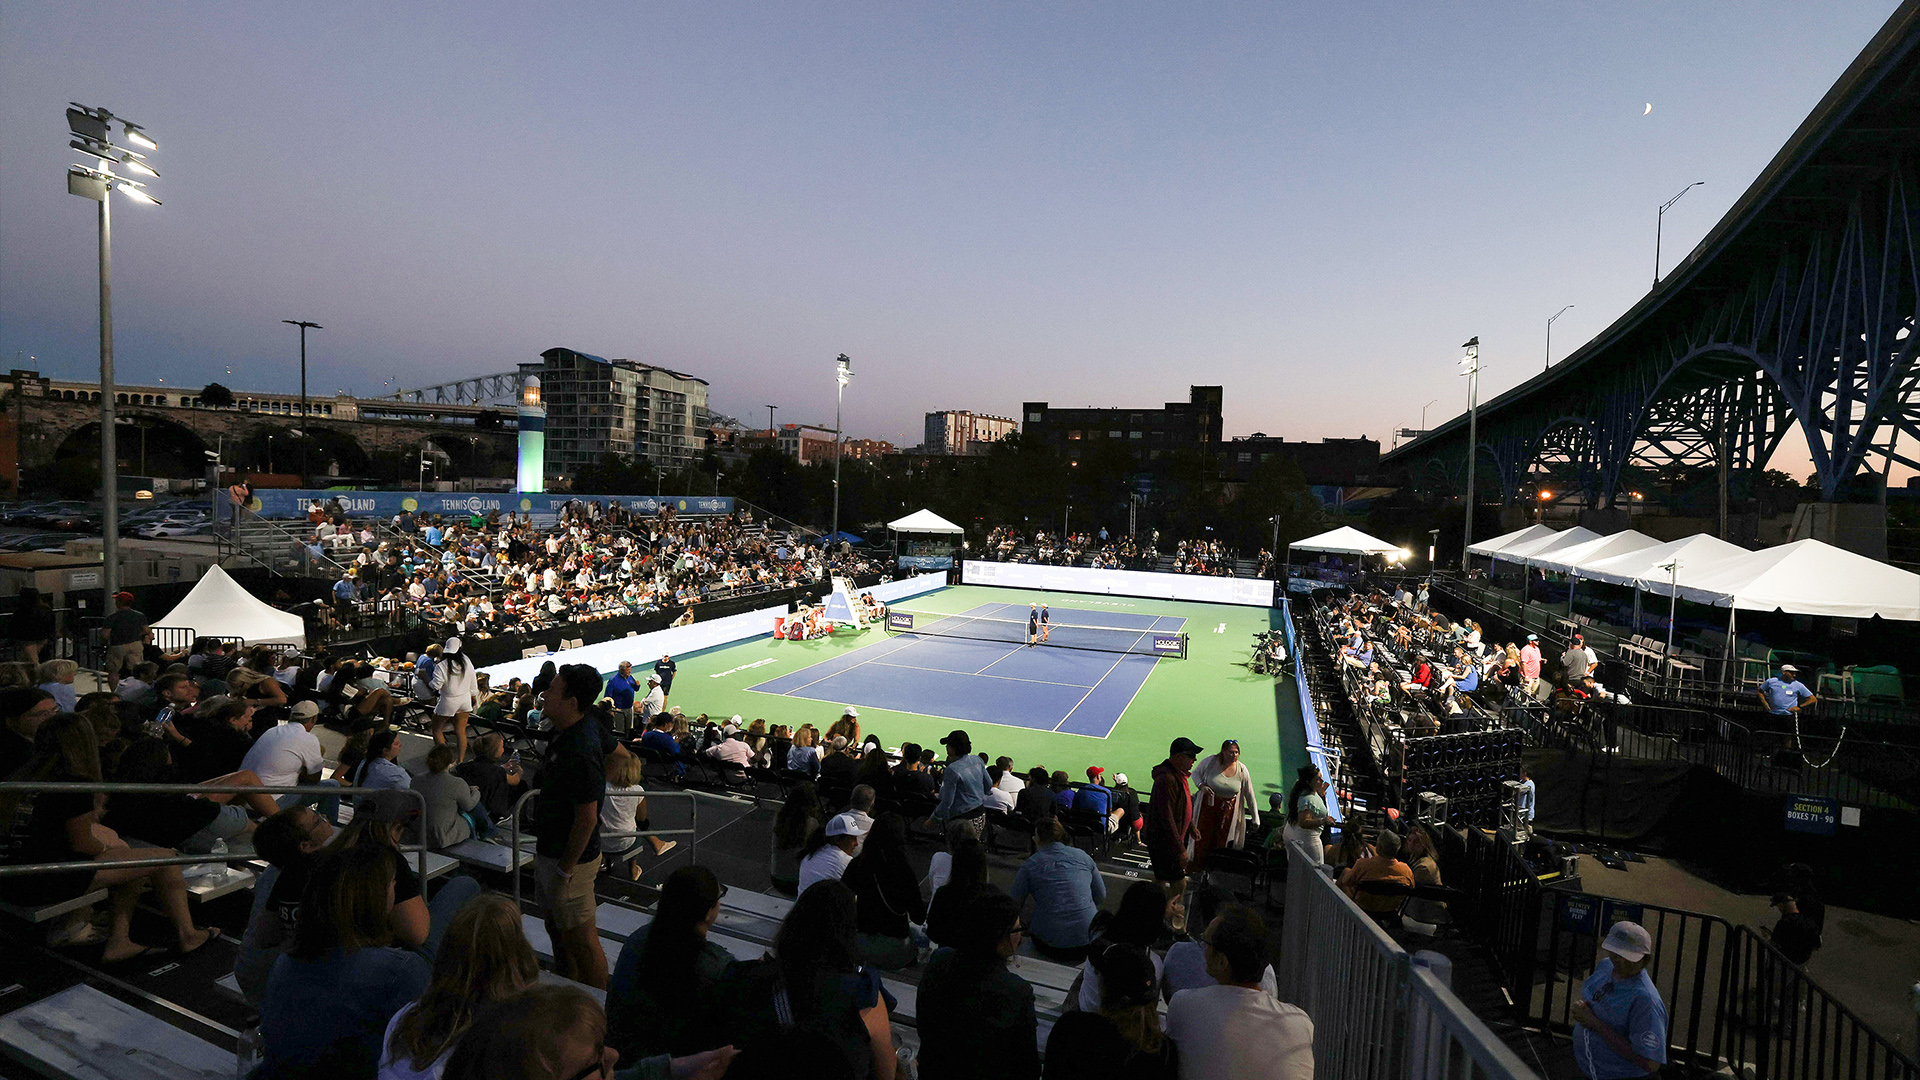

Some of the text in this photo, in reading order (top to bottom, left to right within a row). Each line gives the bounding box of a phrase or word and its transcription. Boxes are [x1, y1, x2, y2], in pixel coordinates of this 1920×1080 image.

[297, 498, 375, 511] TEIS LAND
[441, 499, 501, 511] TENNIS LAND
[1060, 598, 1135, 607] CLEVELAND
[891, 615, 912, 623] HOLOGIC
[1793, 803, 1823, 814] SECTION
[1787, 810, 1810, 821] BOXES
[1810, 814, 1818, 822] 71
[1824, 815, 1835, 824] 90
